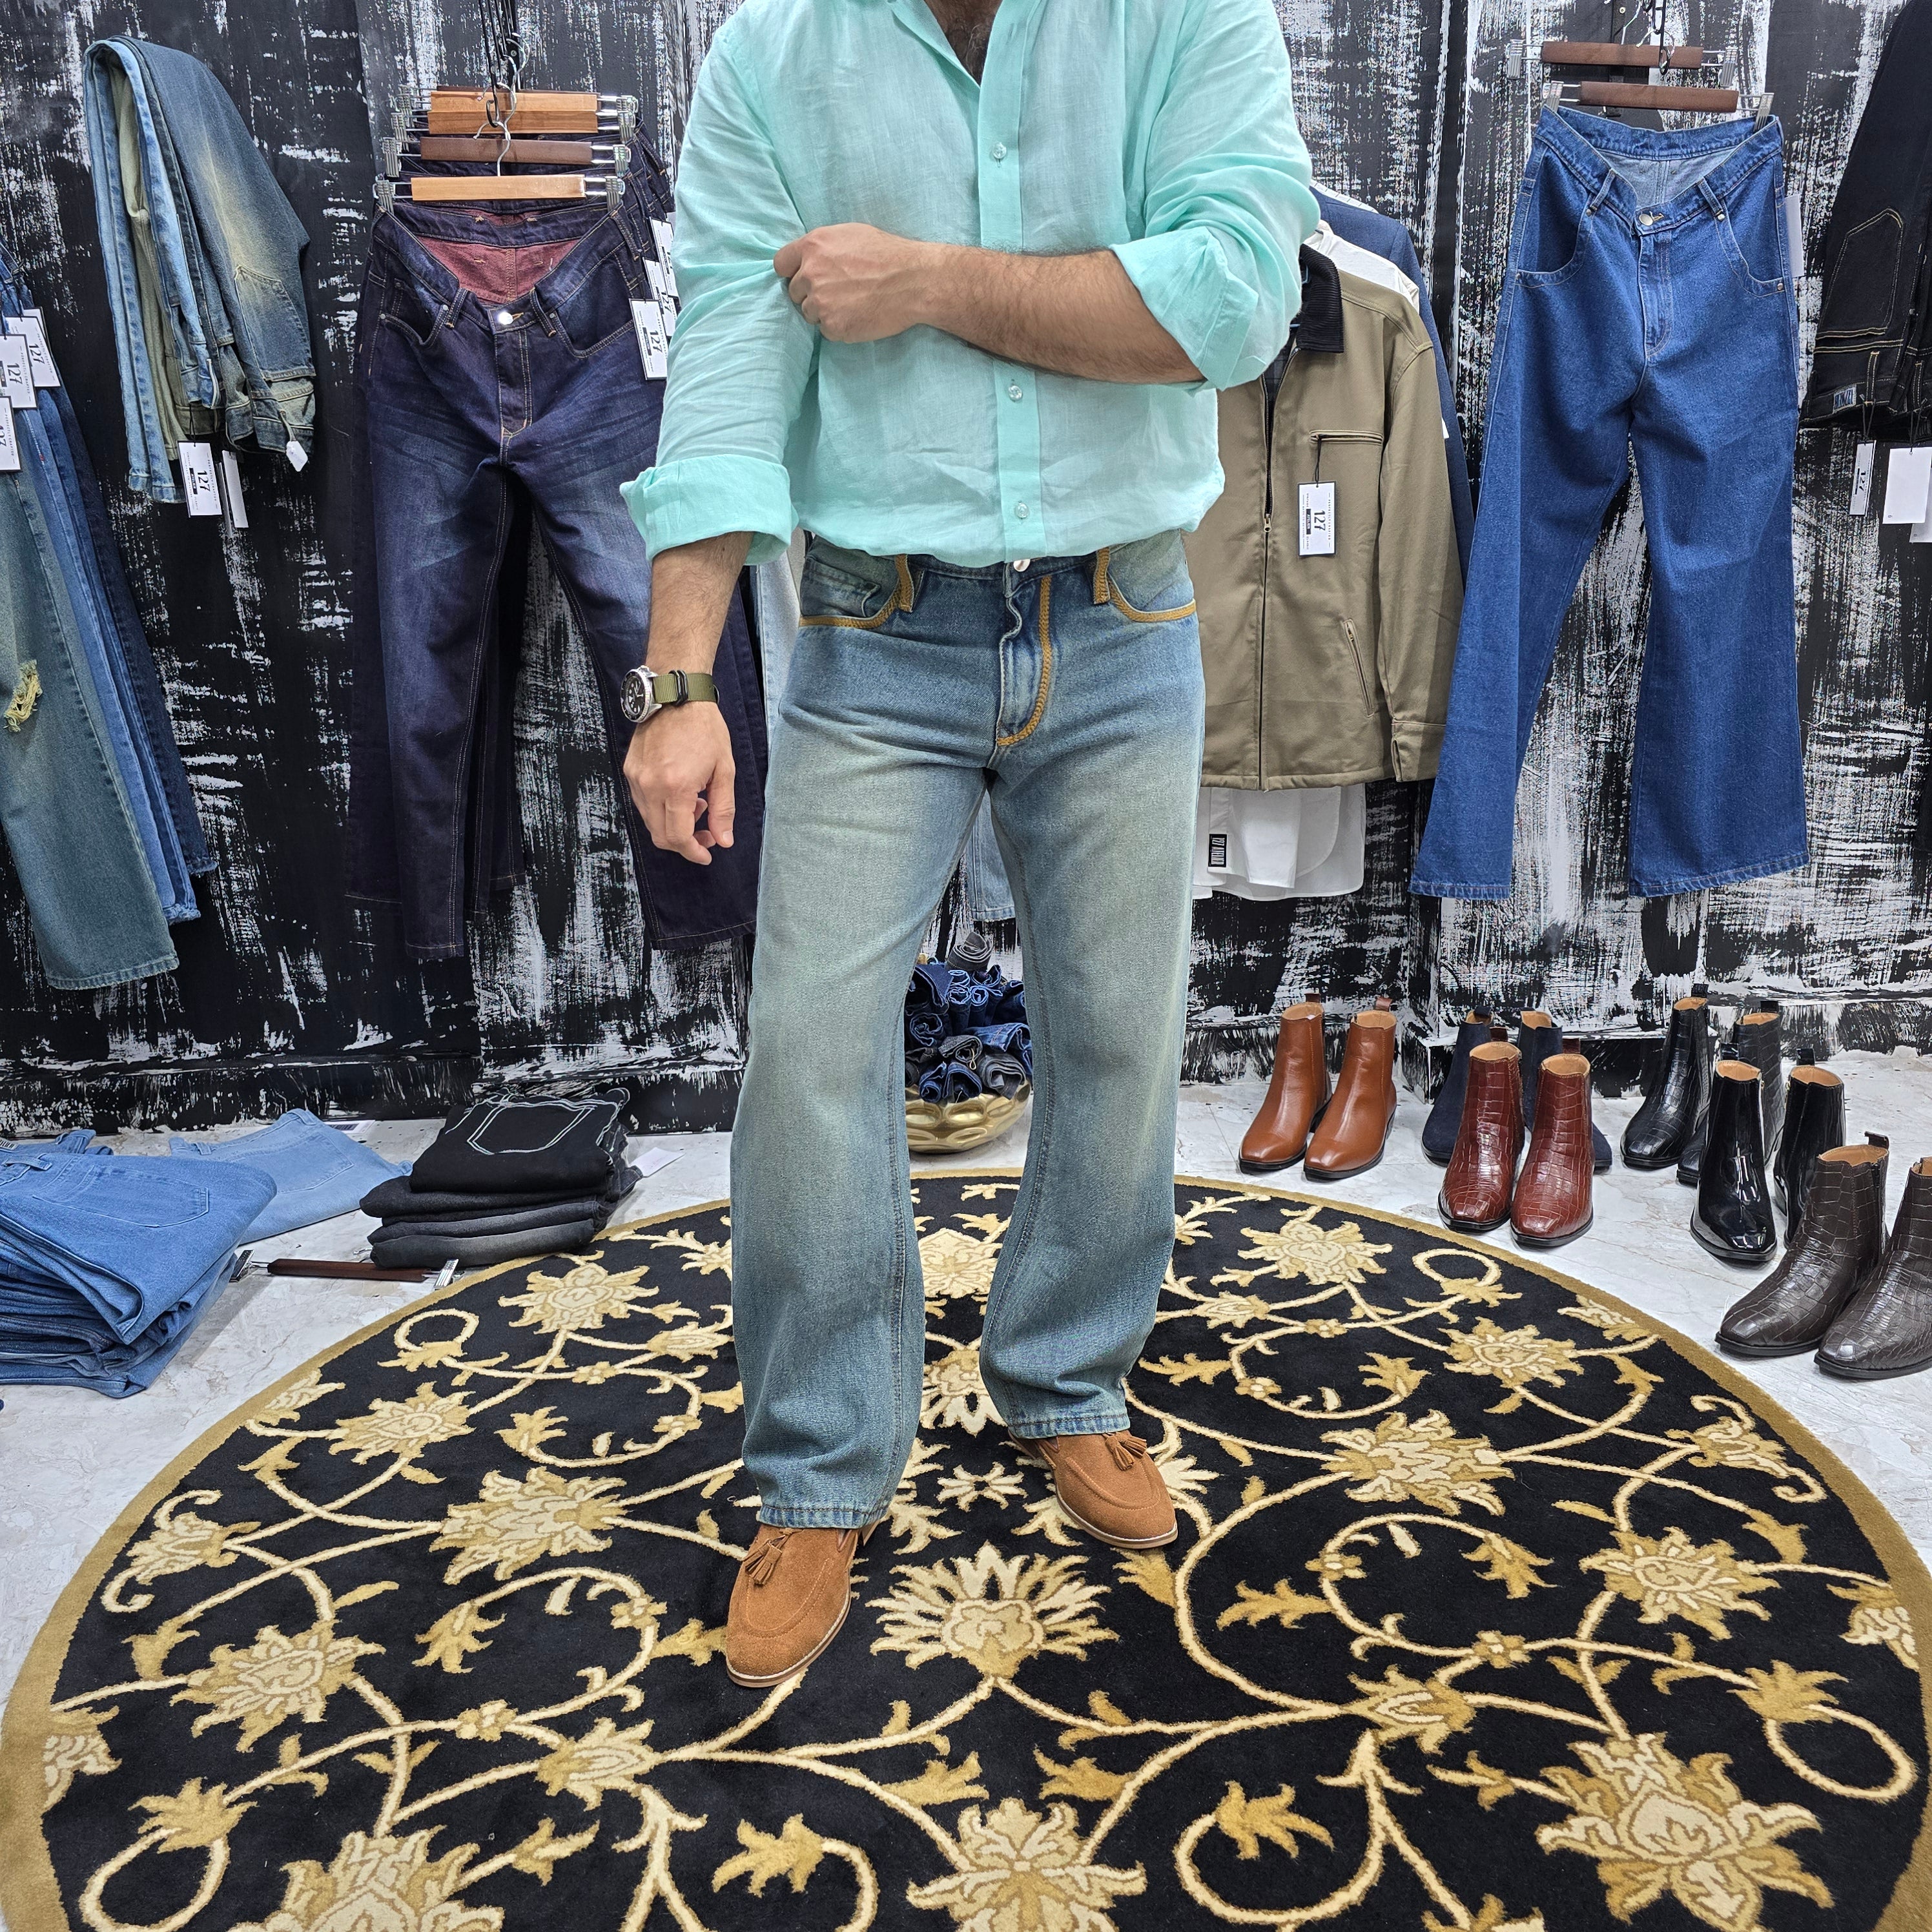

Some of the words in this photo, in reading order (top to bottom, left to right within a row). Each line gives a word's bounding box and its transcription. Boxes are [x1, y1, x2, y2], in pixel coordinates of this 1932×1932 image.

[650, 330, 663, 353] 127
[28, 344, 45, 364] 127
[7, 363, 23, 385] 127
[198, 471, 211, 491] 127
[1314, 510, 1326, 531] 127
